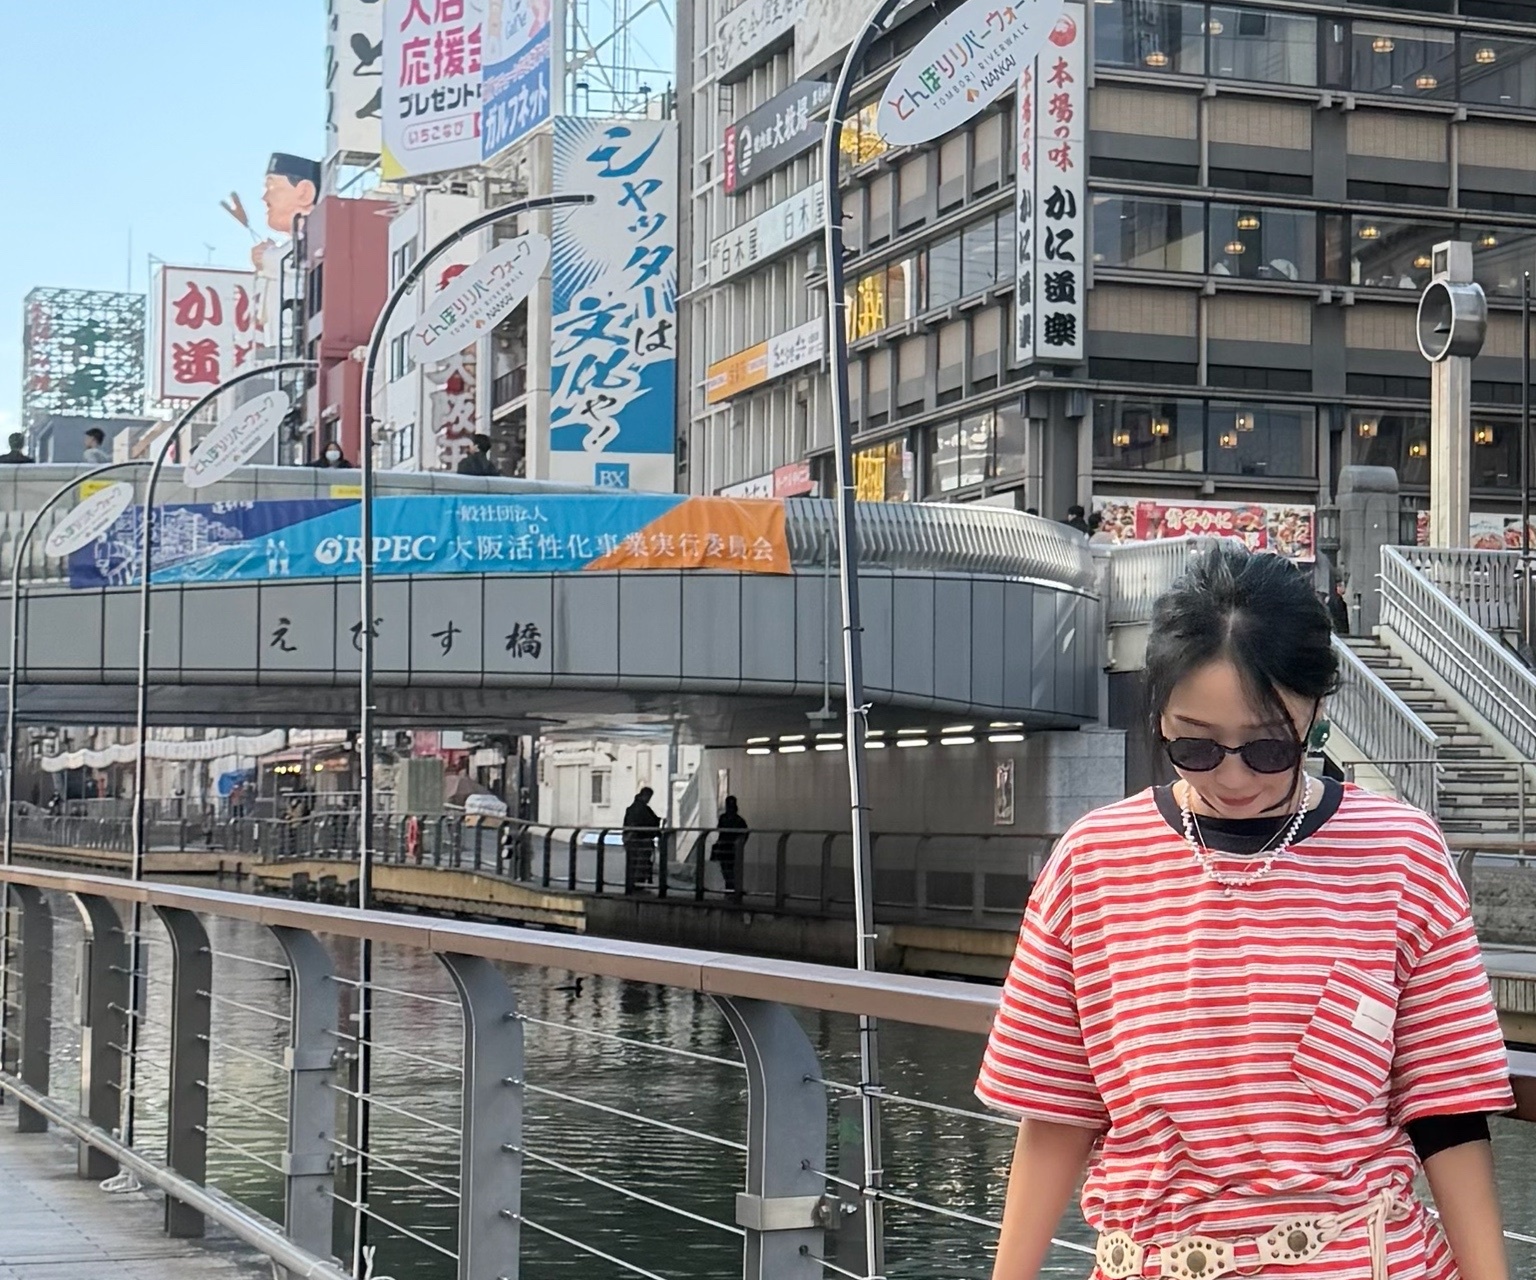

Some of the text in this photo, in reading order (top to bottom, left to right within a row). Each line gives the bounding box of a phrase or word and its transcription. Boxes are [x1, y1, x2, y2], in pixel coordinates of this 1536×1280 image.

[399, 82, 482, 119] プレゼント
[933, 22, 1031, 111] TOMBORI RIVERWALK
[980, 53, 1017, 92] NANKAI
[586, 125, 677, 358] シャッターは
[721, 189, 825, 276] 白木屋 白木屋
[1043, 55, 1078, 348] 本場の味 かに道楽
[413, 239, 533, 347] とんぼりリバーウォーク
[599, 470, 625, 488] BX
